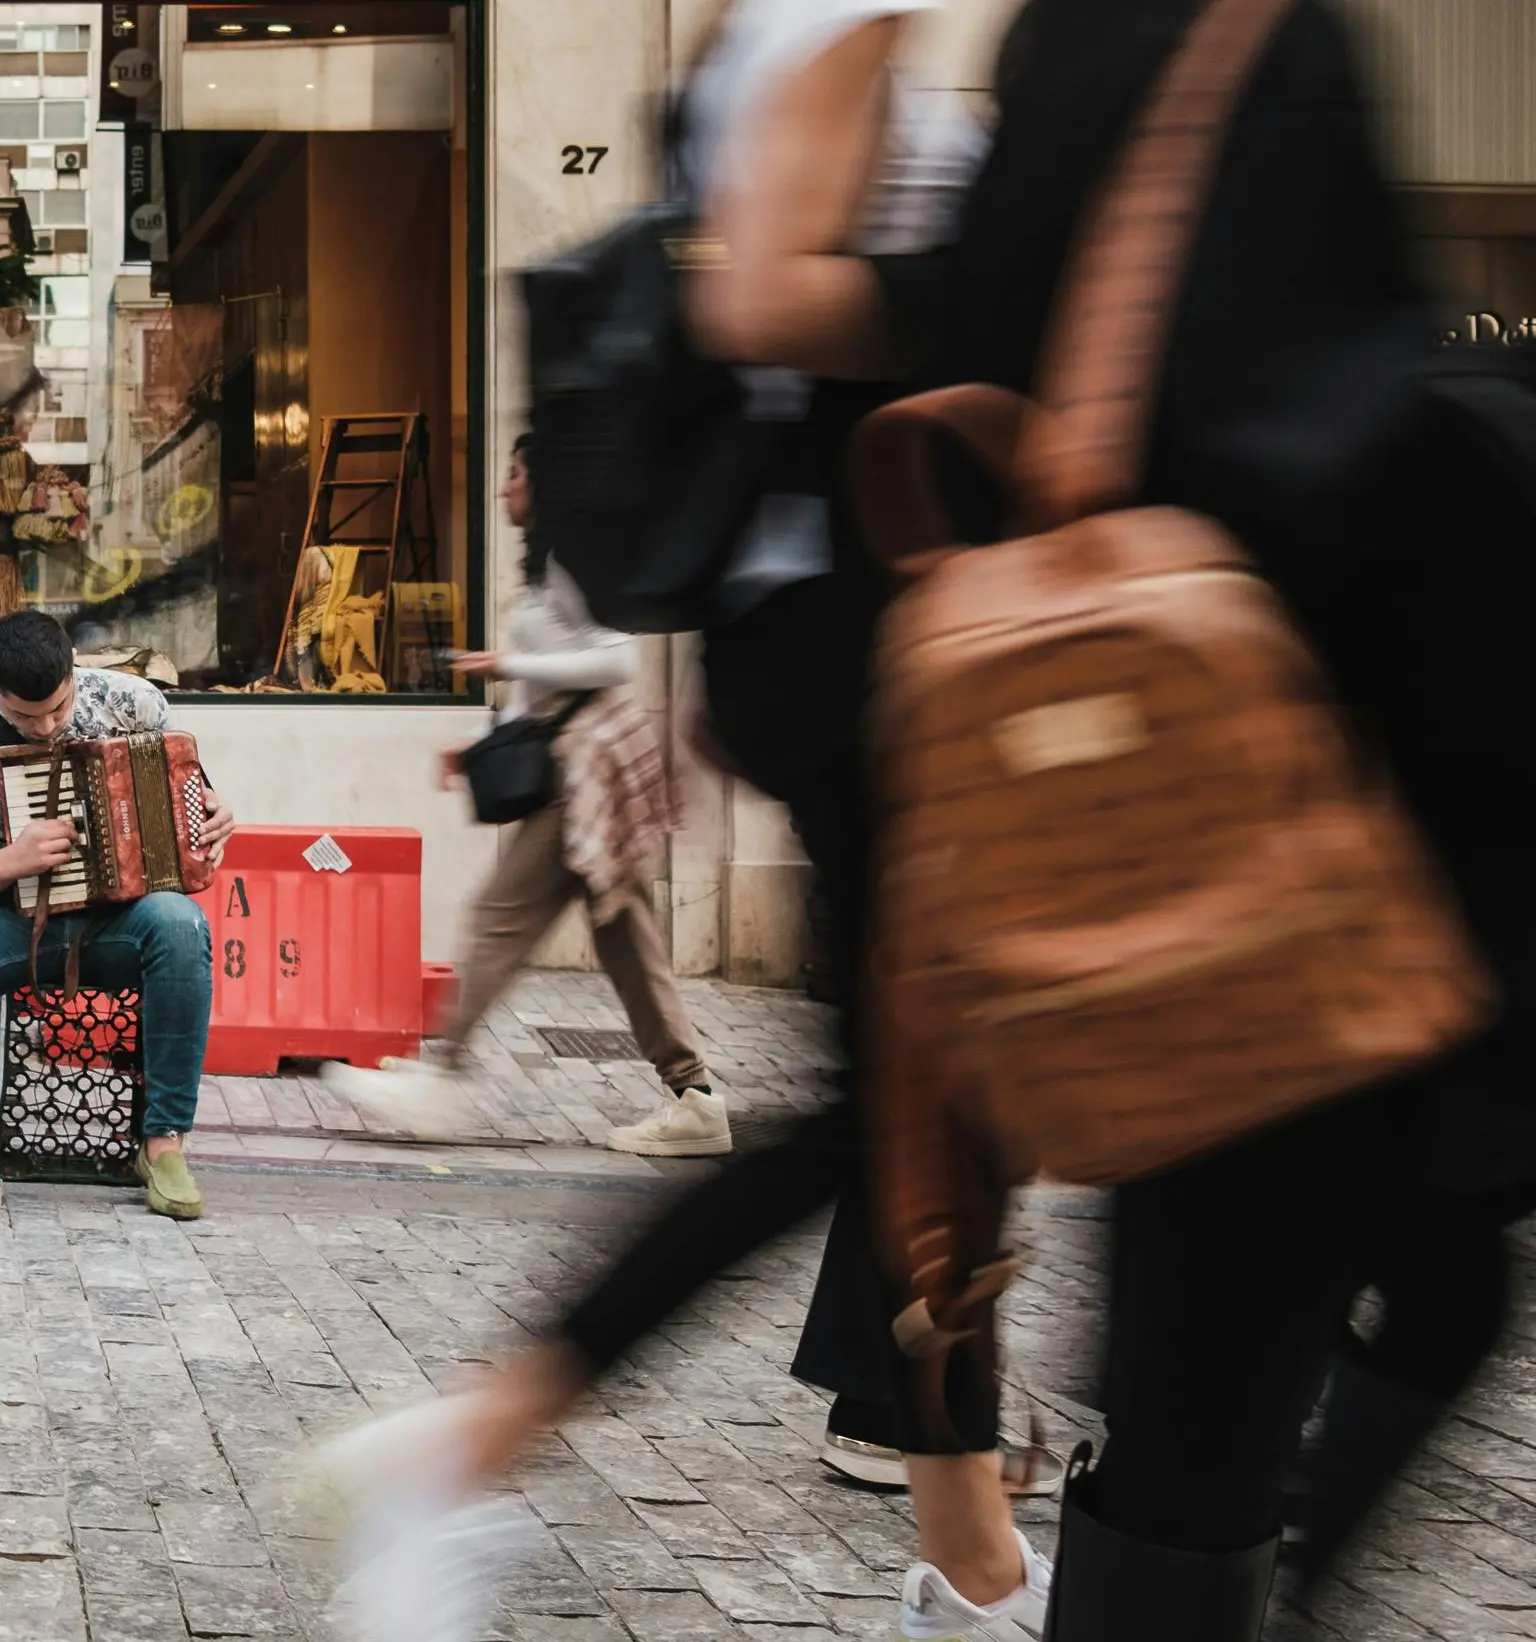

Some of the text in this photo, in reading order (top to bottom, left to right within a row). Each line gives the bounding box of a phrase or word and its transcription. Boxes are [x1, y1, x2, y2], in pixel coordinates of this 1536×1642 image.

[562, 145, 609, 175] 27
[120, 800, 132, 840] HOHNER
[225, 877, 251, 917] A
